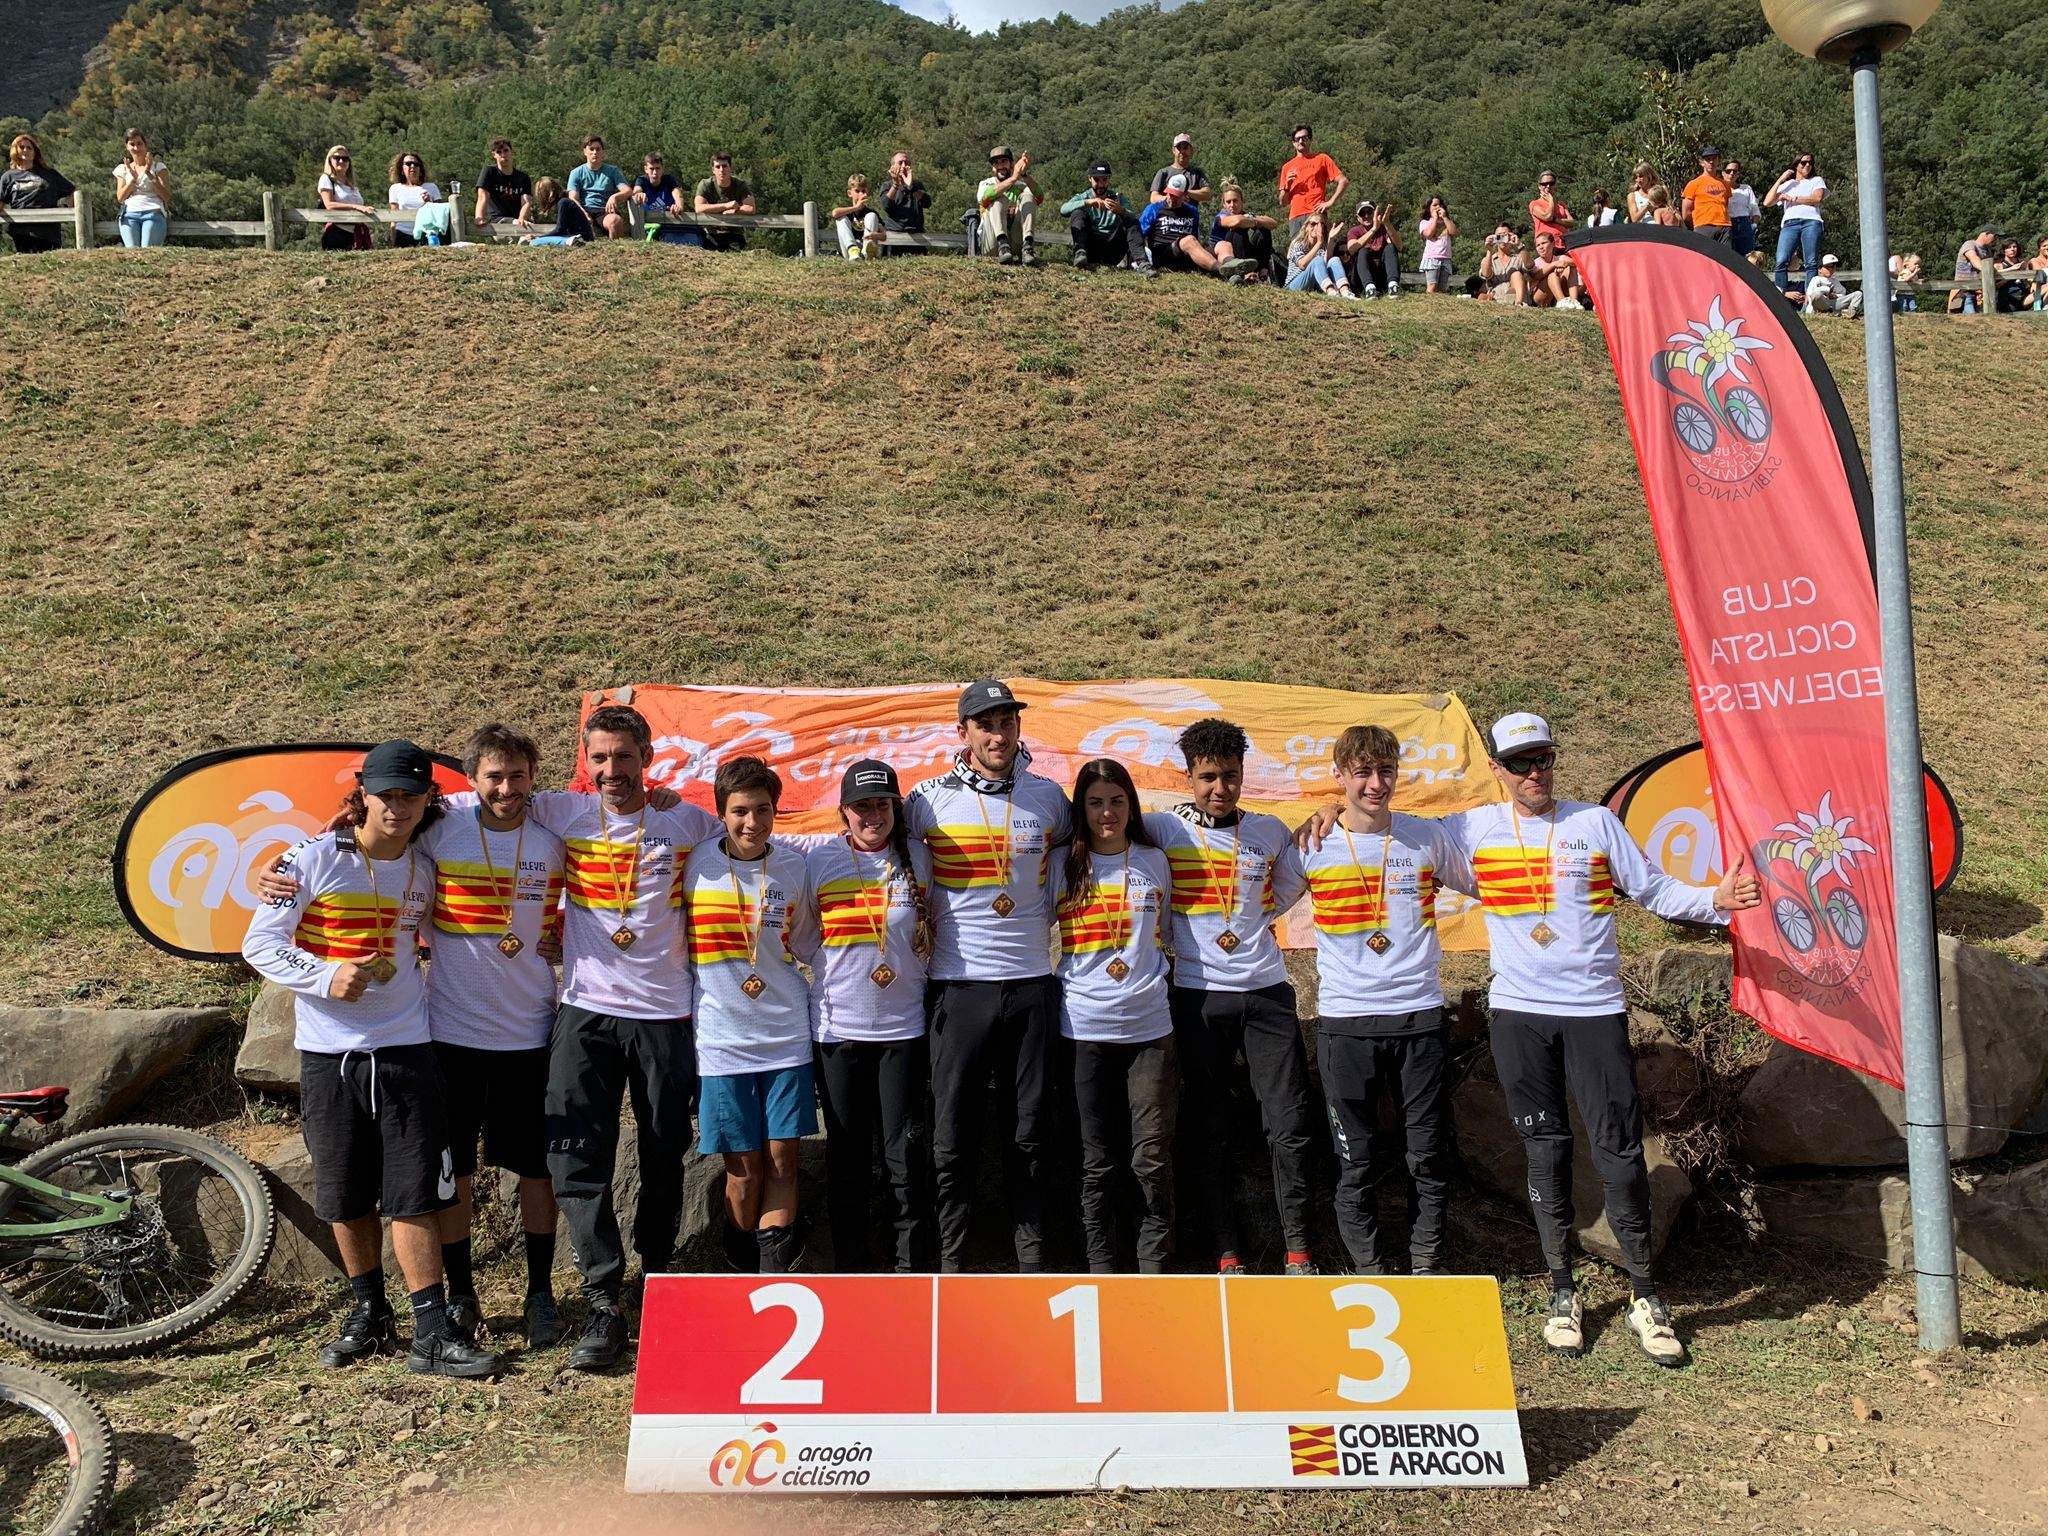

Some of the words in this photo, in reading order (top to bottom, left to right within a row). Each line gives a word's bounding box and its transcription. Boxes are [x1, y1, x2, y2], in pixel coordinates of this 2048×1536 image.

[519, 861, 547, 872] ULEVEL
[1513, 1110, 1546, 1127] FOX
[549, 1138, 586, 1151] FOX
[739, 1282, 825, 1405] 2
[1048, 1284, 1103, 1404] 1
[1330, 1283, 1411, 1403] 3
[1339, 1423, 1480, 1448] GOBIERNO
[798, 1441, 873, 1467] aragón
[1341, 1451, 1379, 1476] DE
[1389, 1450, 1506, 1476] ARAGON
[781, 1465, 871, 1487] ciclismo
